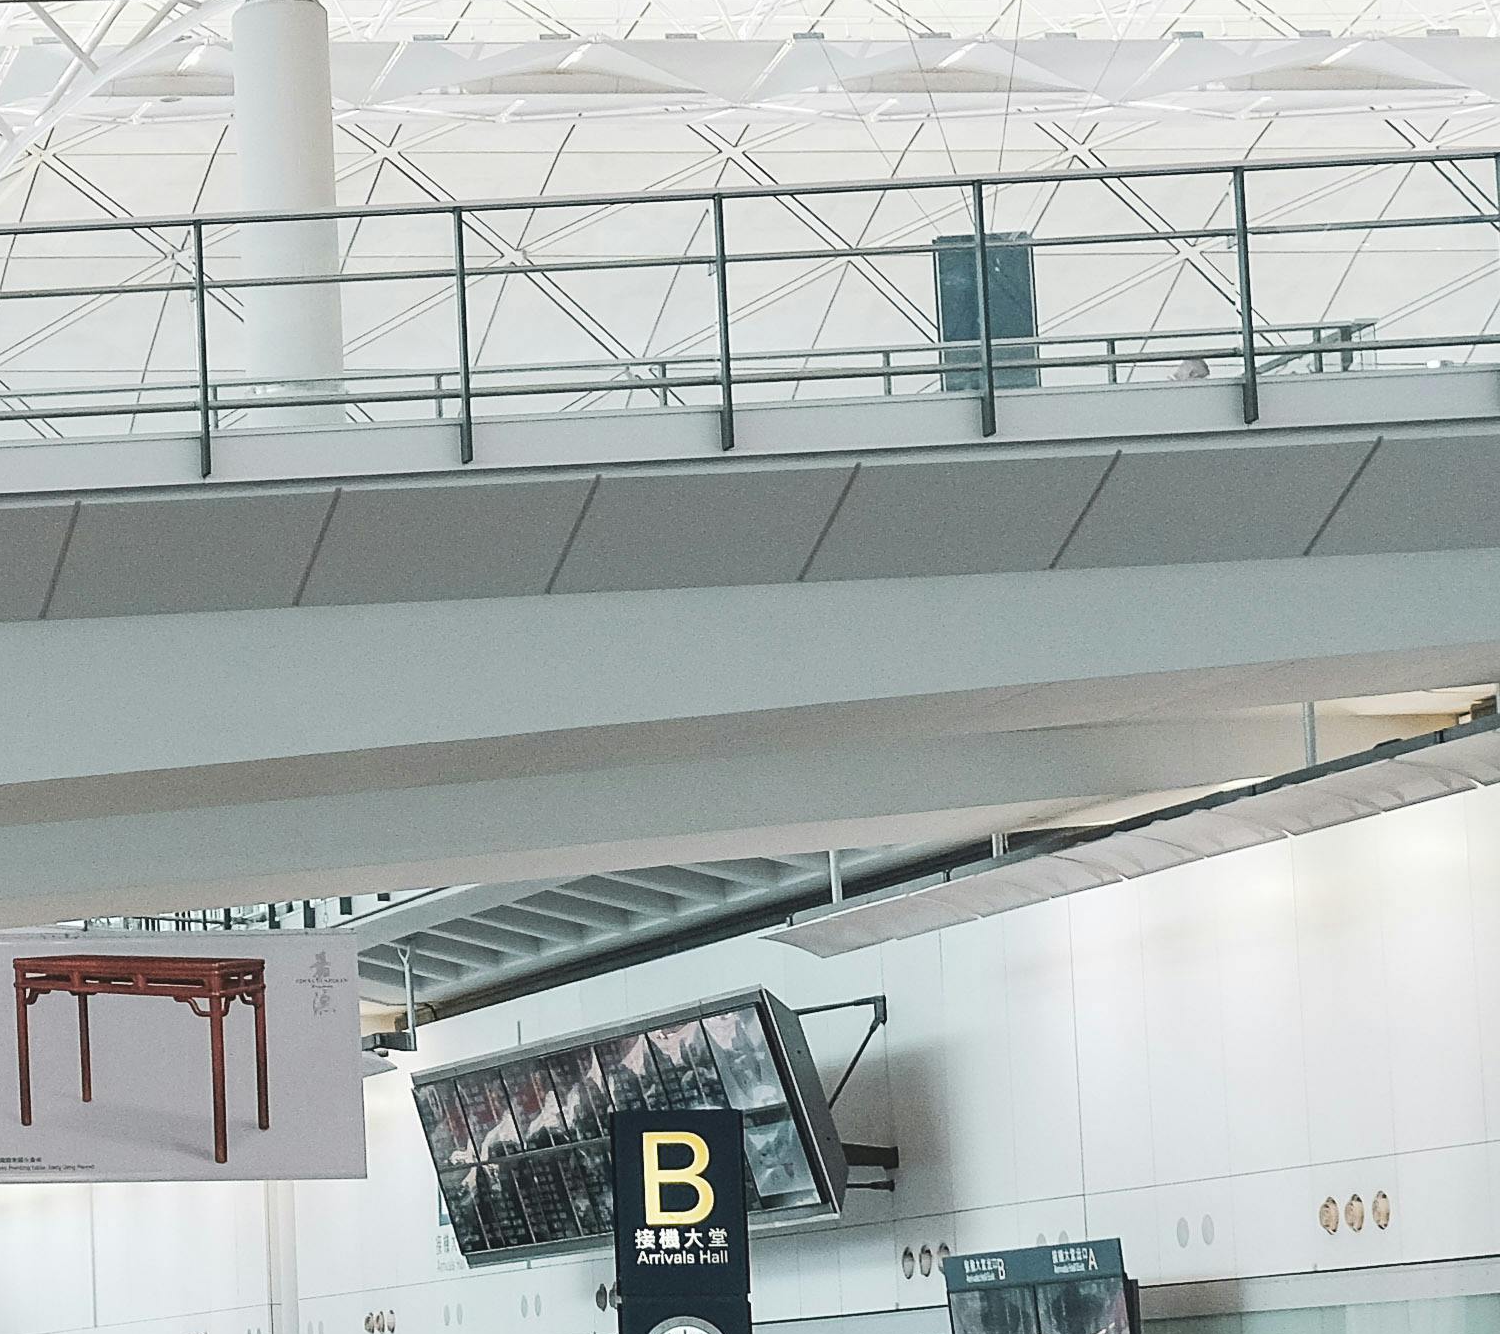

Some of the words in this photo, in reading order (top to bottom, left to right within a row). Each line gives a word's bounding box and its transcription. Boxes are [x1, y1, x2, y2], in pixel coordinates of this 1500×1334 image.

[642, 1131, 715, 1226] B
[634, 1227, 729, 1250] 接機大堂
[636, 1251, 695, 1265] Arrivals
[699, 1250, 729, 1264] Hall
[1088, 1247, 1099, 1272] A
